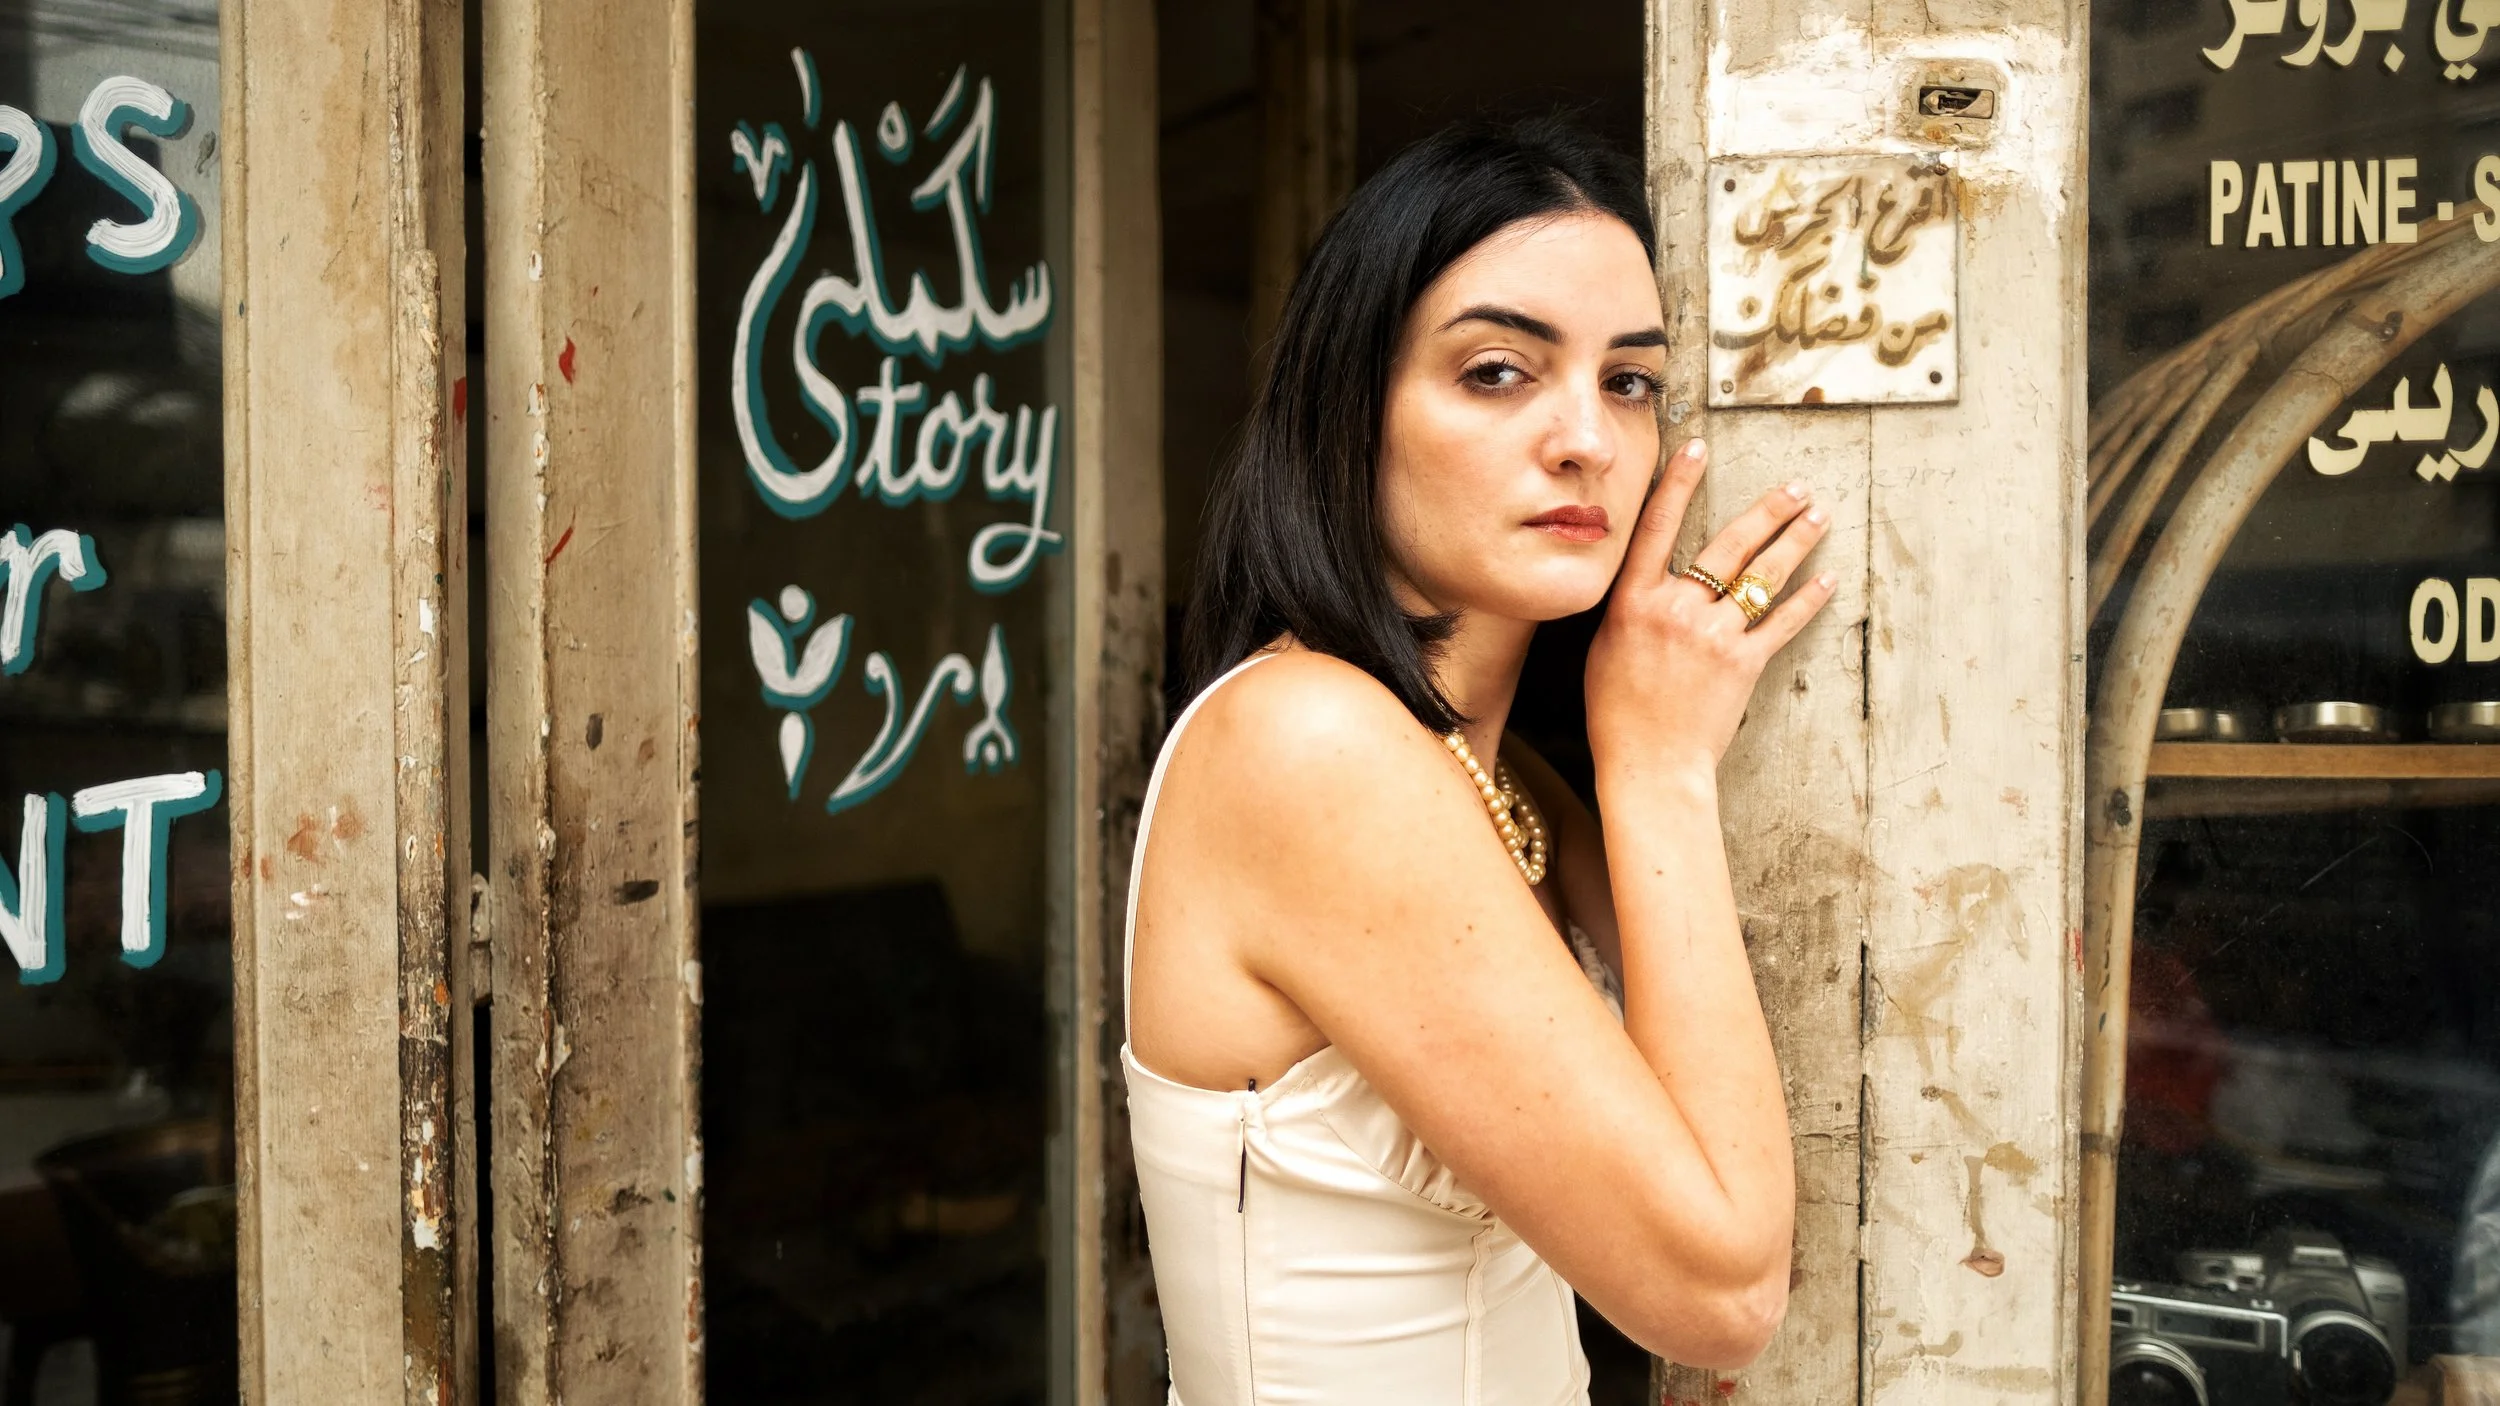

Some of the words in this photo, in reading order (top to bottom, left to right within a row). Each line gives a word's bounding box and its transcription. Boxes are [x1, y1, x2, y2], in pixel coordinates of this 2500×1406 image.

[2210, 158, 2418, 247] PATINE
[1878, 313, 1948, 367] من
[793, 275, 1064, 584] Story
[2409, 577, 2500, 664] OD
